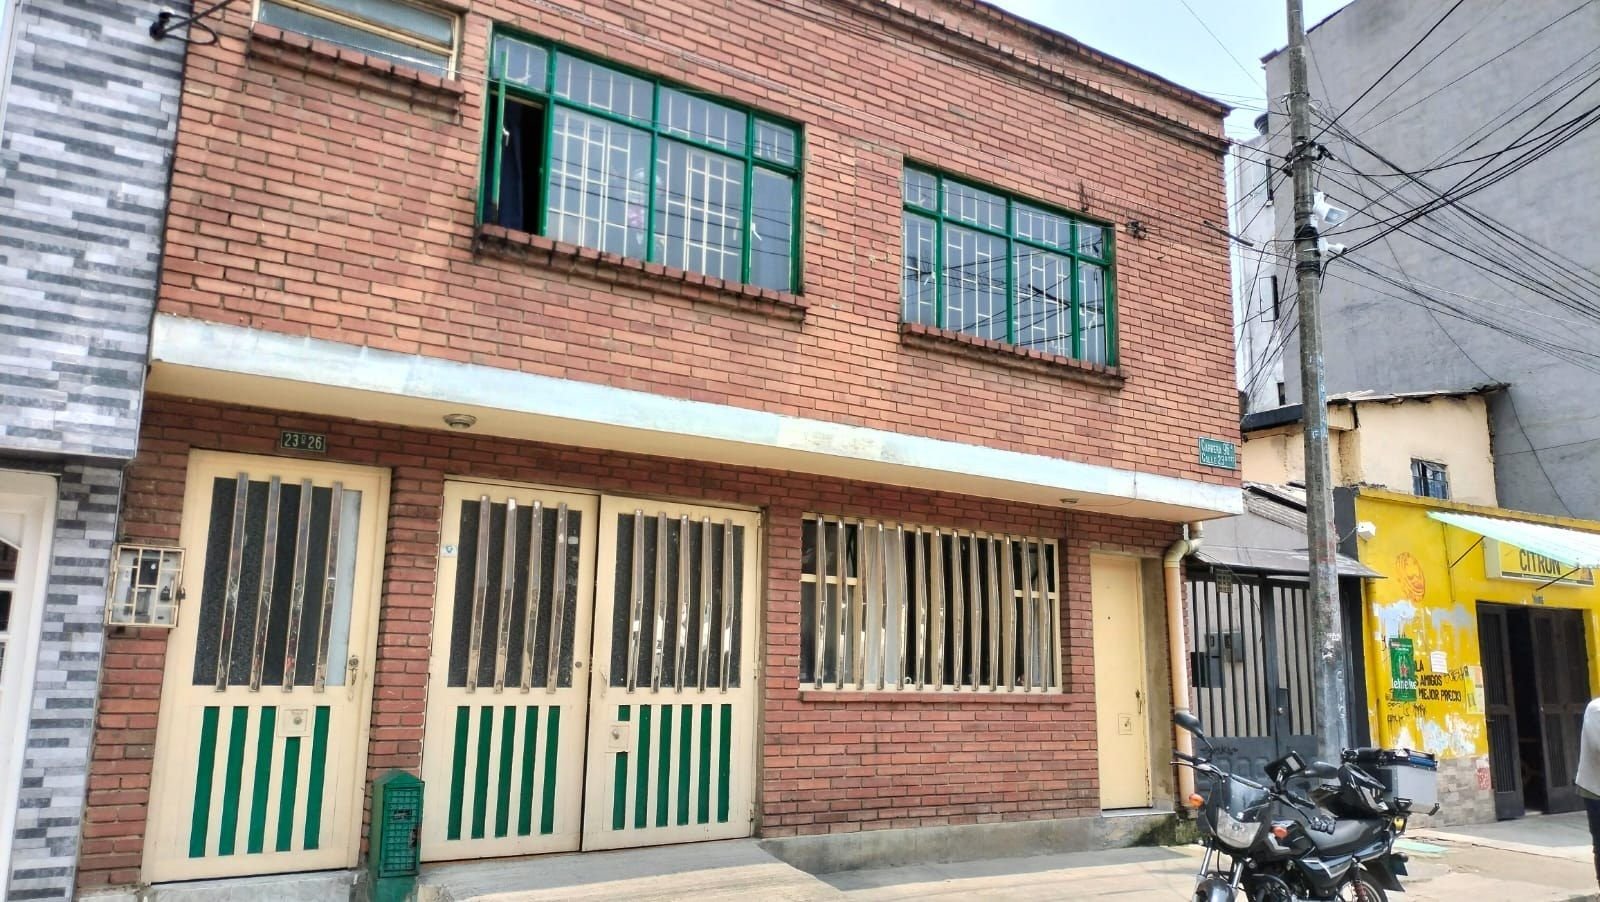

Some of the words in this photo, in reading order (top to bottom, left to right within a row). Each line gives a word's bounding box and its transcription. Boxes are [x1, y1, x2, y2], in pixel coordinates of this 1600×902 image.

[1420, 675, 1443, 686] AMIGOS
[1418, 688, 1440, 700] MEJOR
[1440, 690, 1462, 702] PRECIO
